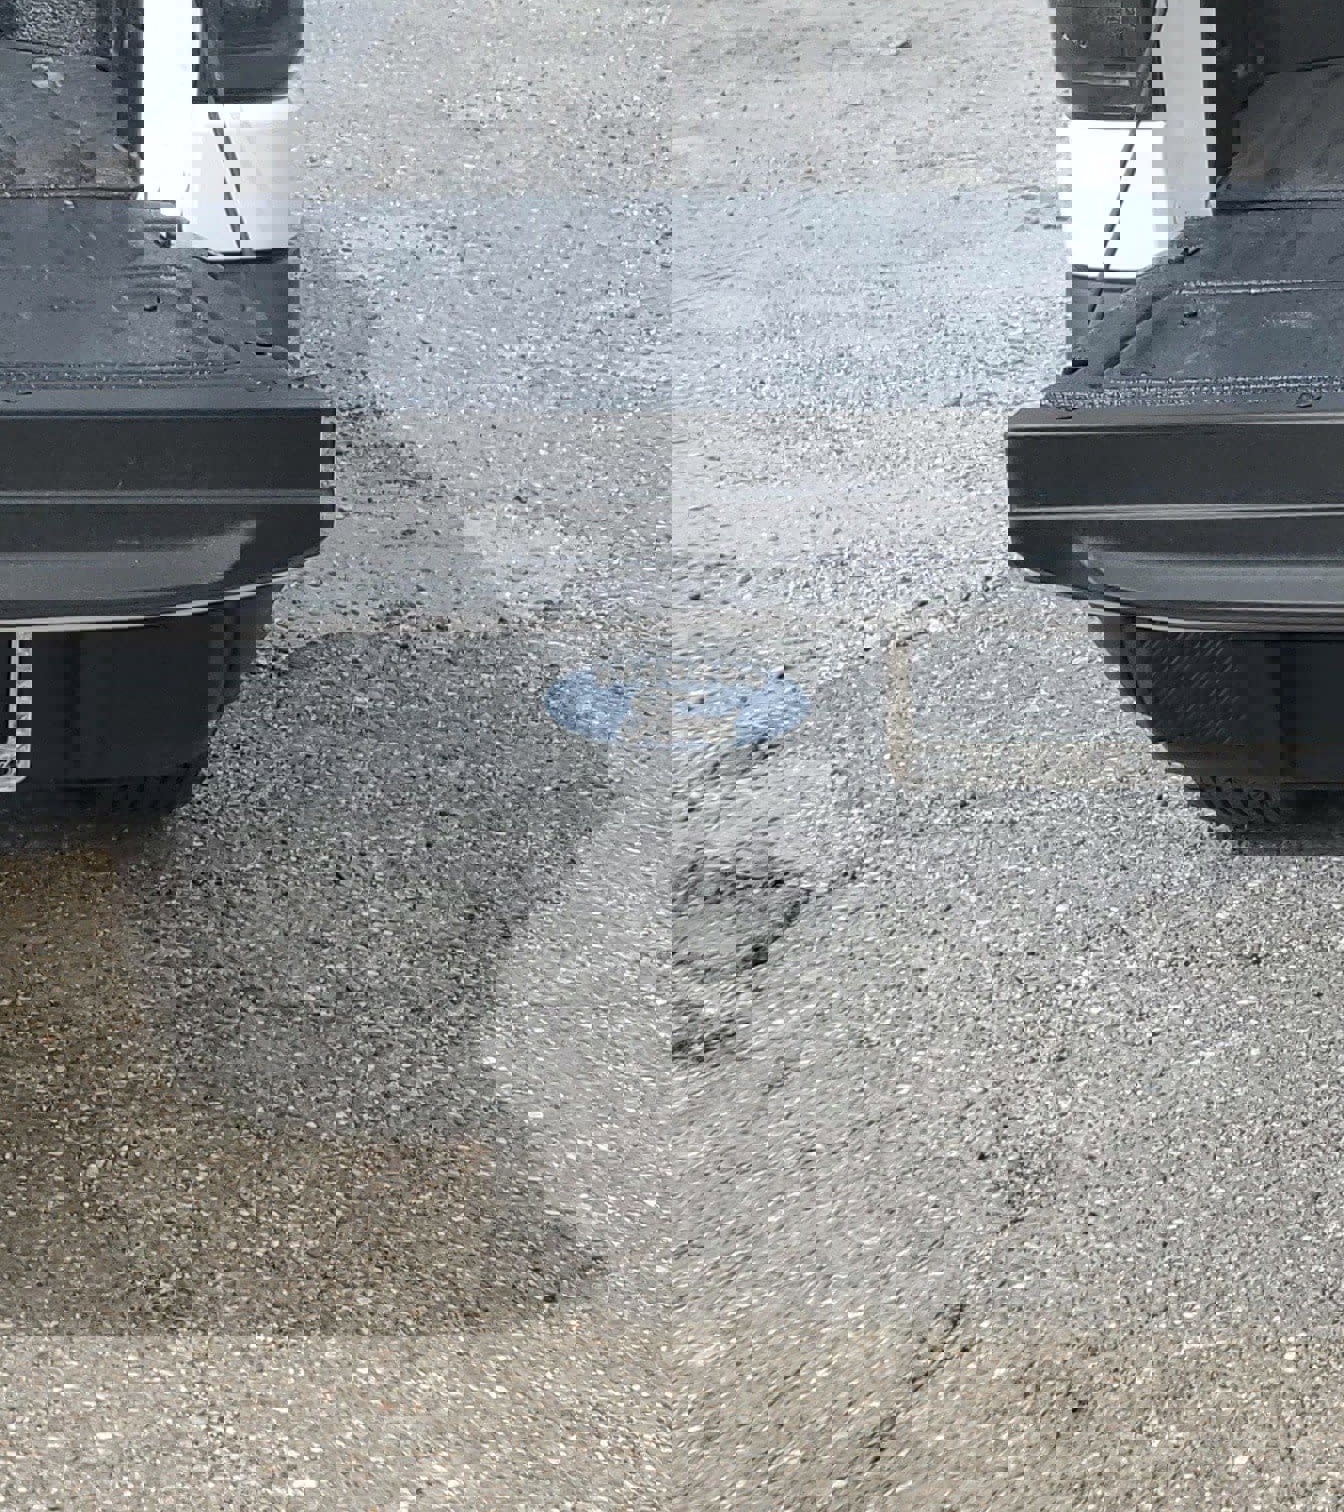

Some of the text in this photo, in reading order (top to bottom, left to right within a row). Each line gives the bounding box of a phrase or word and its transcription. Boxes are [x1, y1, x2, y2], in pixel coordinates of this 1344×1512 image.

[592, 660, 767, 692] BRANDON
[618, 687, 743, 745] Ford
[990, 748, 1287, 777] BRANDON
